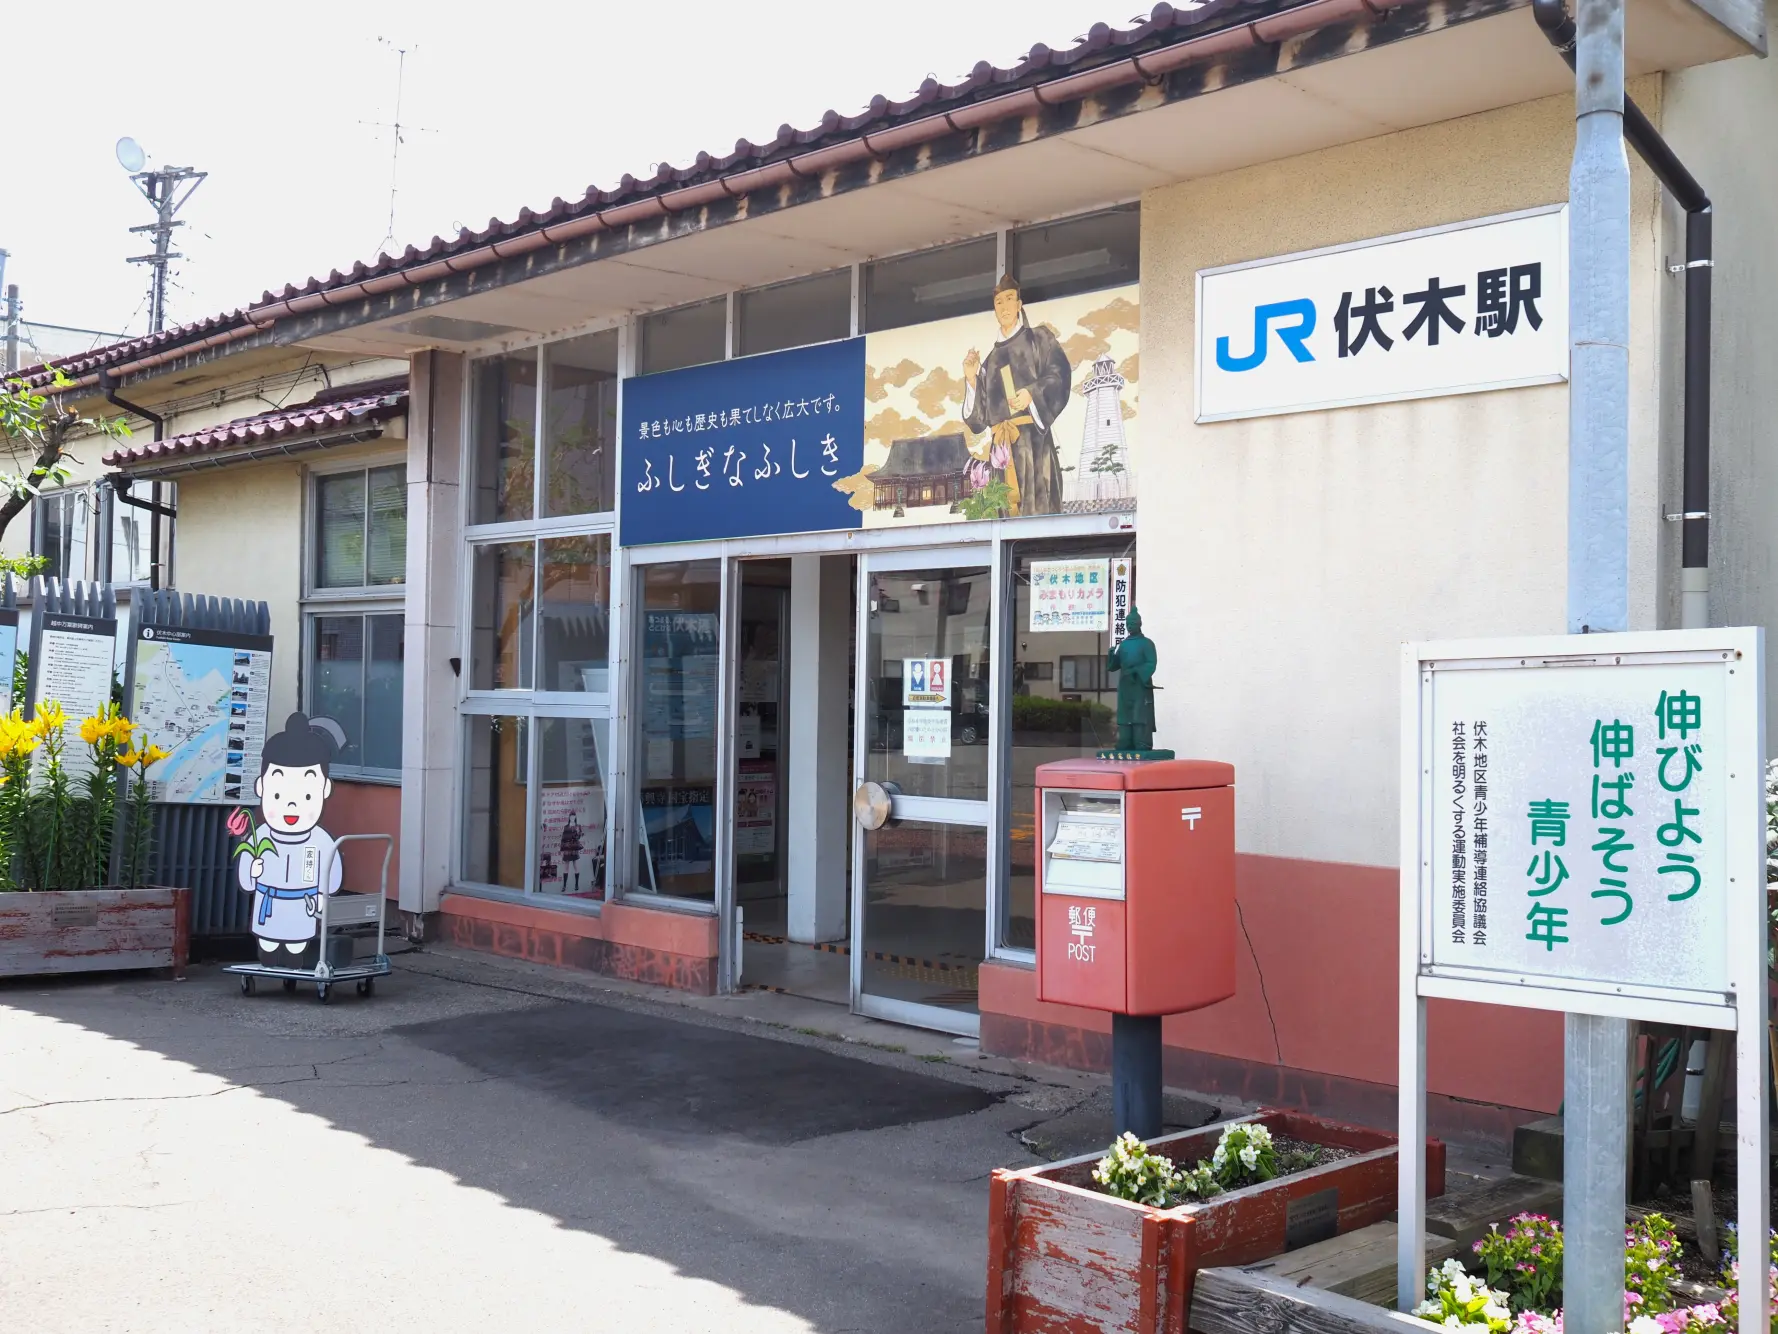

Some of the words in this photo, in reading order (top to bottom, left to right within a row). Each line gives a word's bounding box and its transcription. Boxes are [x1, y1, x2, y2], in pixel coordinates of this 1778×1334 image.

[1216, 298, 1316, 373] JR
[1333, 262, 1543, 358] 伏木駅
[638, 393, 840, 440] 景色も心も歴史も果てしなく広大です。
[637, 433, 839, 492] ふしぎなふしき
[1039, 588, 1104, 601] みまもりカメラ
[1049, 572, 1099, 585] 伏木地区
[1451, 721, 1466, 945] 社会を明るくする運動実施委員会
[1473, 720, 1488, 947] 伏木地区青少年補導連絡協議会
[1590, 718, 1635, 925] 伸ばそう
[1655, 690, 1702, 902] 伸びよう
[1068, 905, 1096, 927] 郵便
[1525, 798, 1570, 952] 青少年
[1068, 942, 1096, 963] POST
